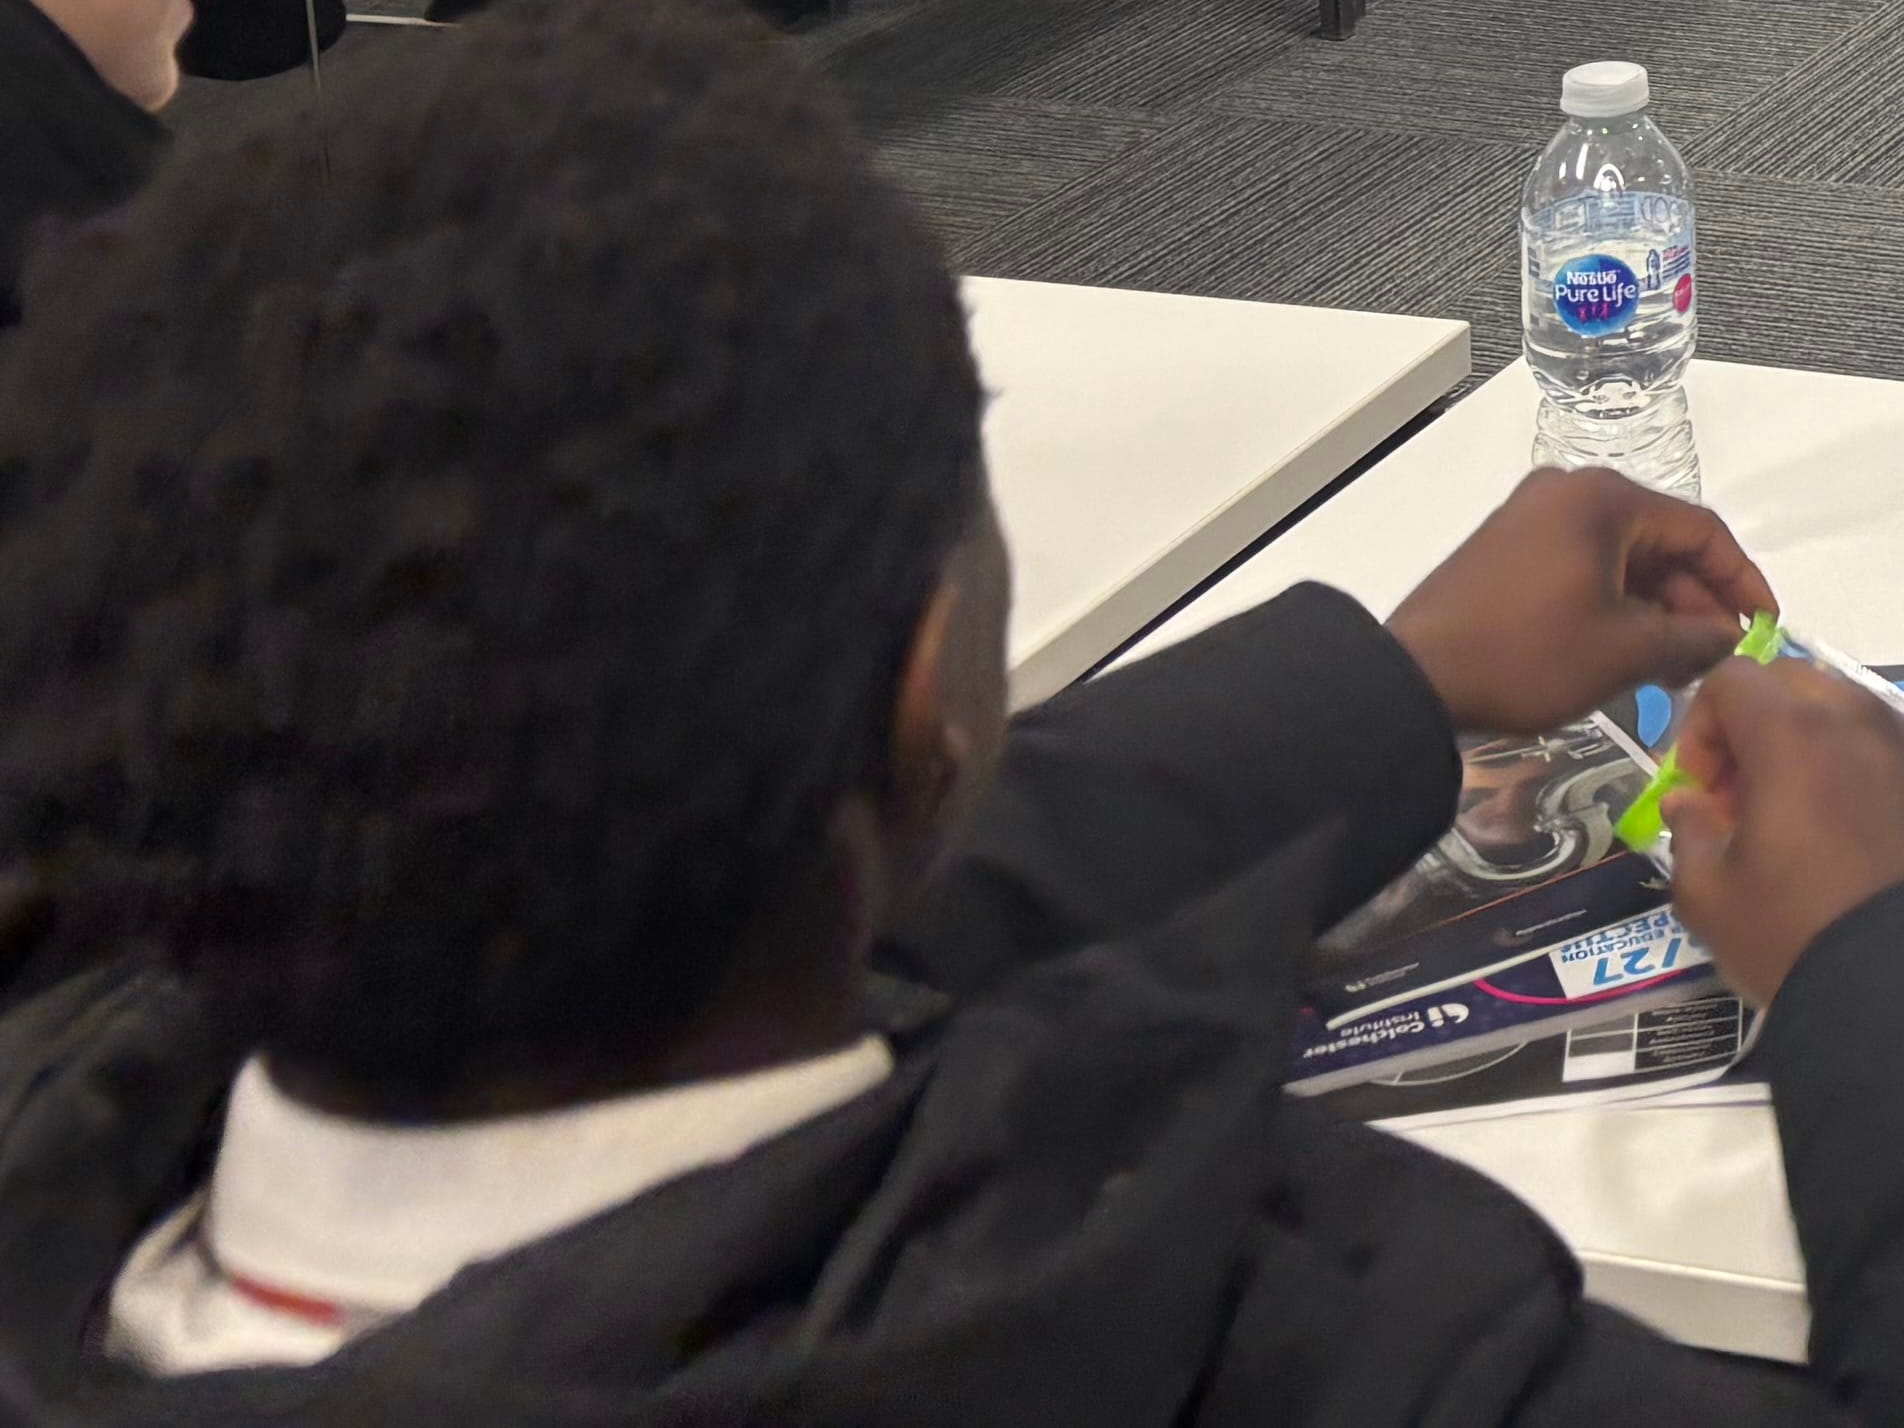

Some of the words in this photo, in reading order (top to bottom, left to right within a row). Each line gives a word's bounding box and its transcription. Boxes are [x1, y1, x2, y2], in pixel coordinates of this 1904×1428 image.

[1555, 284, 1600, 302] Pure
[1602, 282, 1637, 308] Life
[1561, 929, 1665, 964] EDUCATION
[1303, 1020, 1425, 1058] Colchester
[1340, 1010, 1420, 1037] Institute
